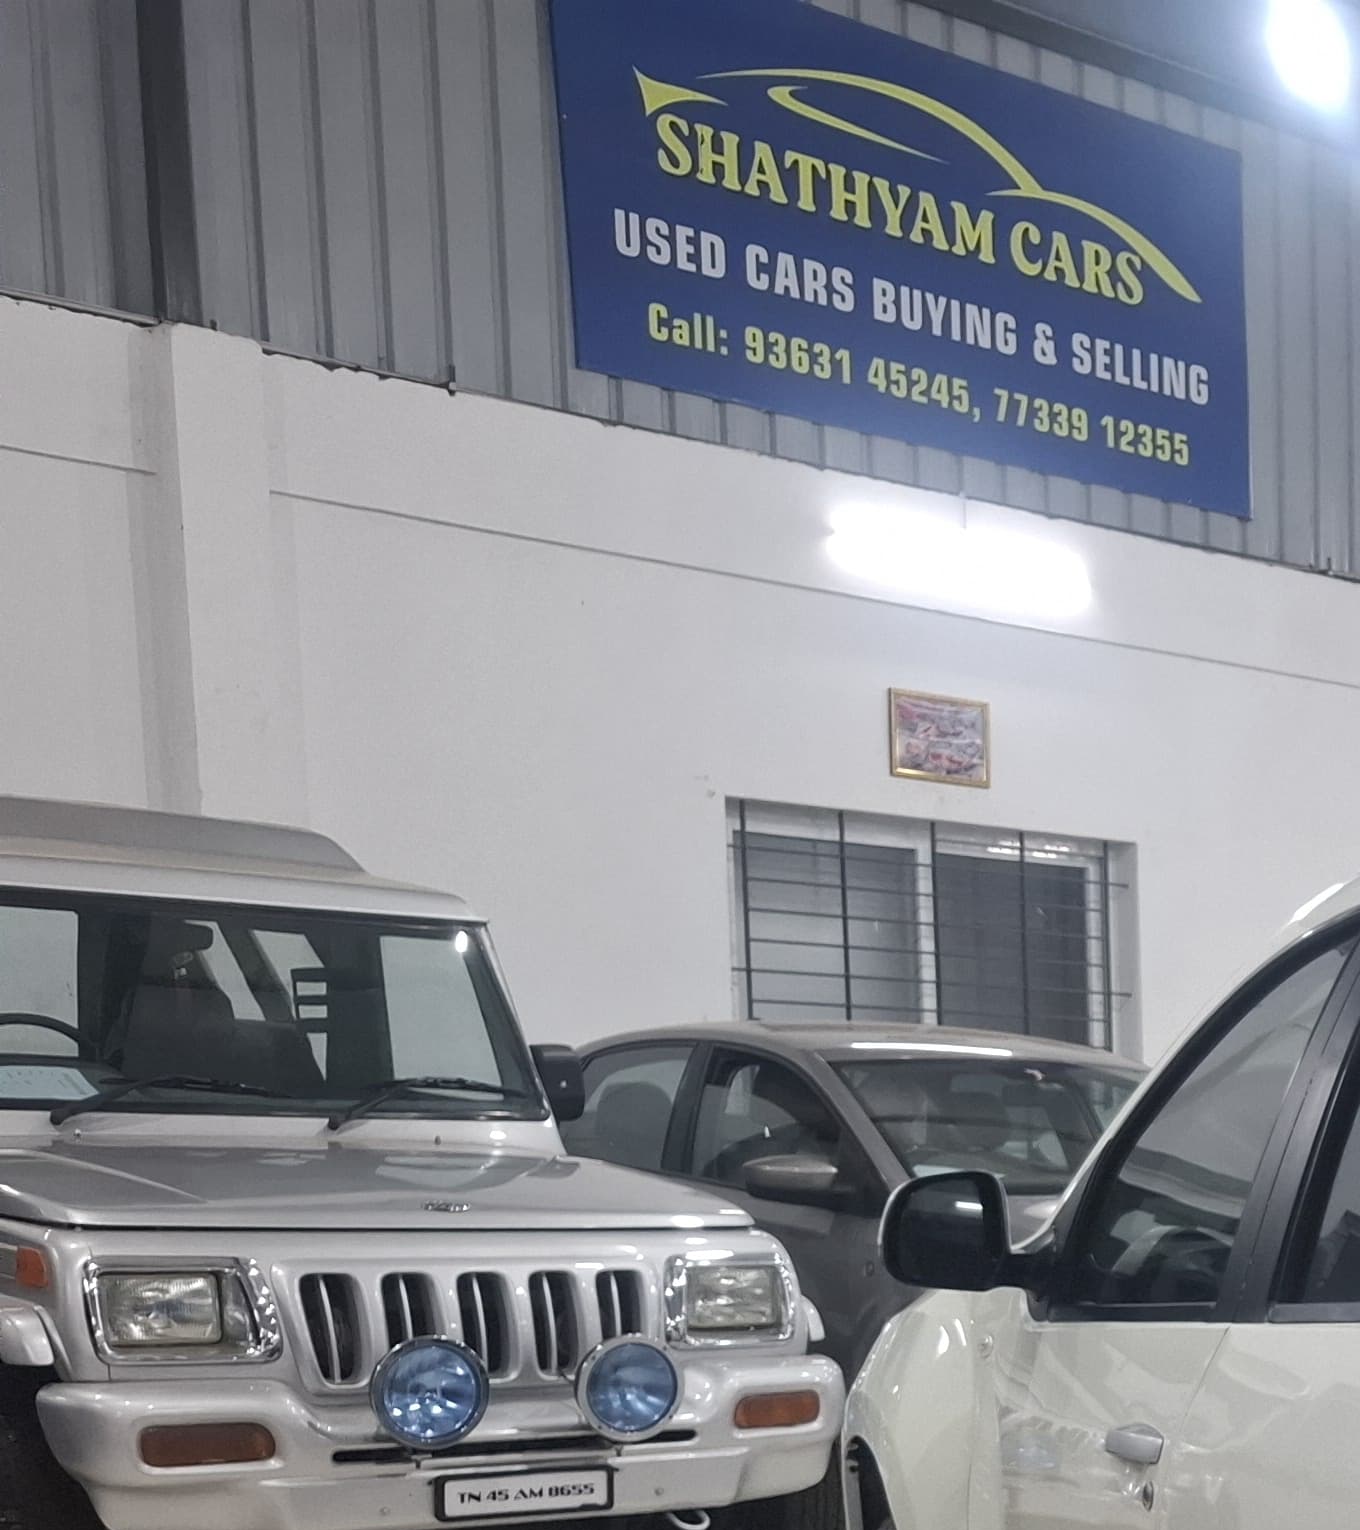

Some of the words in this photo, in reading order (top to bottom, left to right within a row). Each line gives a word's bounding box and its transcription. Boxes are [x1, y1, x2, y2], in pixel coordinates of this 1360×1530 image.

[655, 114, 996, 265] SHATHYAM
[1010, 221, 1145, 306] CARS
[614, 209, 726, 278] USED
[746, 243, 855, 312] CARS
[873, 277, 1017, 357] BUYING
[1033, 322, 1057, 365] &
[1072, 332, 1210, 407] SELLING
[648, 302, 729, 356] Call:
[745, 325, 852, 385] 93631
[868, 362, 981, 422] 45245,
[993, 388, 1089, 441] 77339
[1101, 415, 1190, 466] 12355
[458, 1491, 481, 1504] TN
[486, 1489, 509, 1501] 45
[513, 1487, 544, 1500] AM
[548, 1482, 595, 1497] 8655
